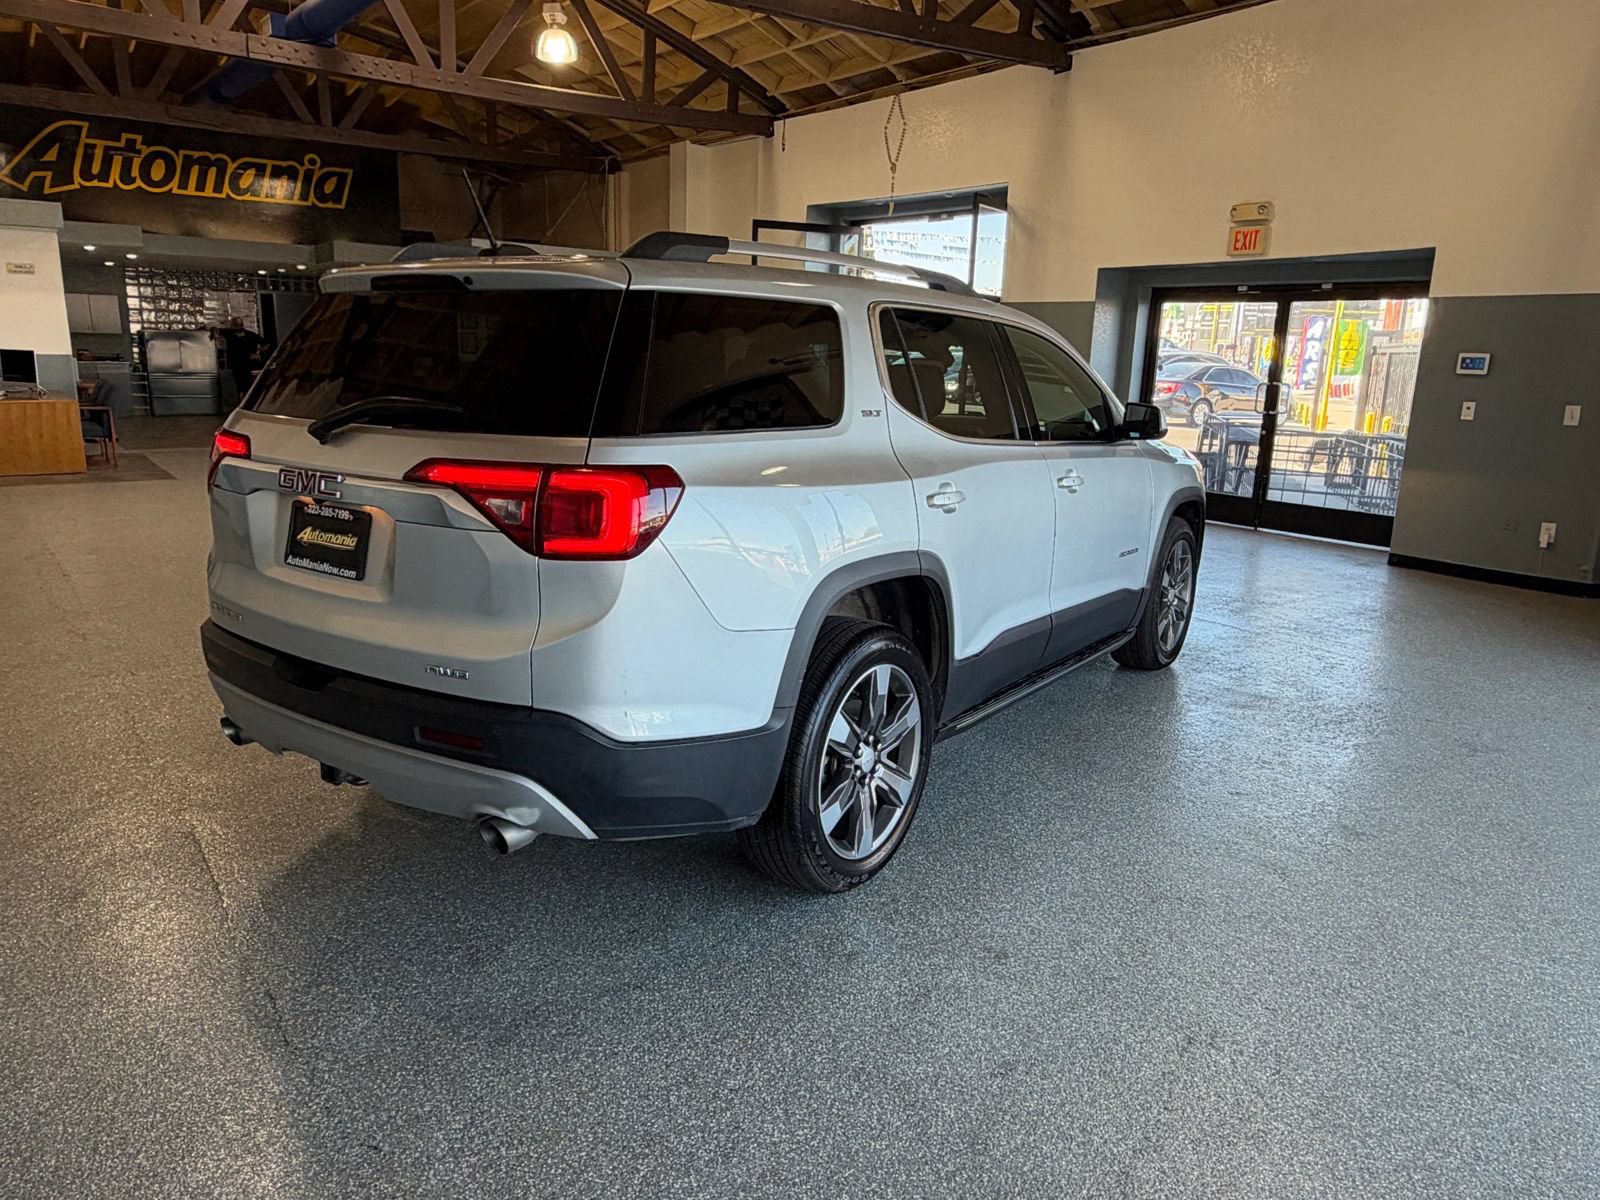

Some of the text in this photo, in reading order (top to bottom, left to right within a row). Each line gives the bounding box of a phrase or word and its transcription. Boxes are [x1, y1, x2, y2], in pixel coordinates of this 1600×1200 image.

[0, 120, 354, 209] Automania
[1233, 229, 1261, 251] EXIT
[279, 469, 345, 499] GMC
[297, 526, 358, 546] Automania
[286, 554, 357, 579] AutoManiaNow.com
